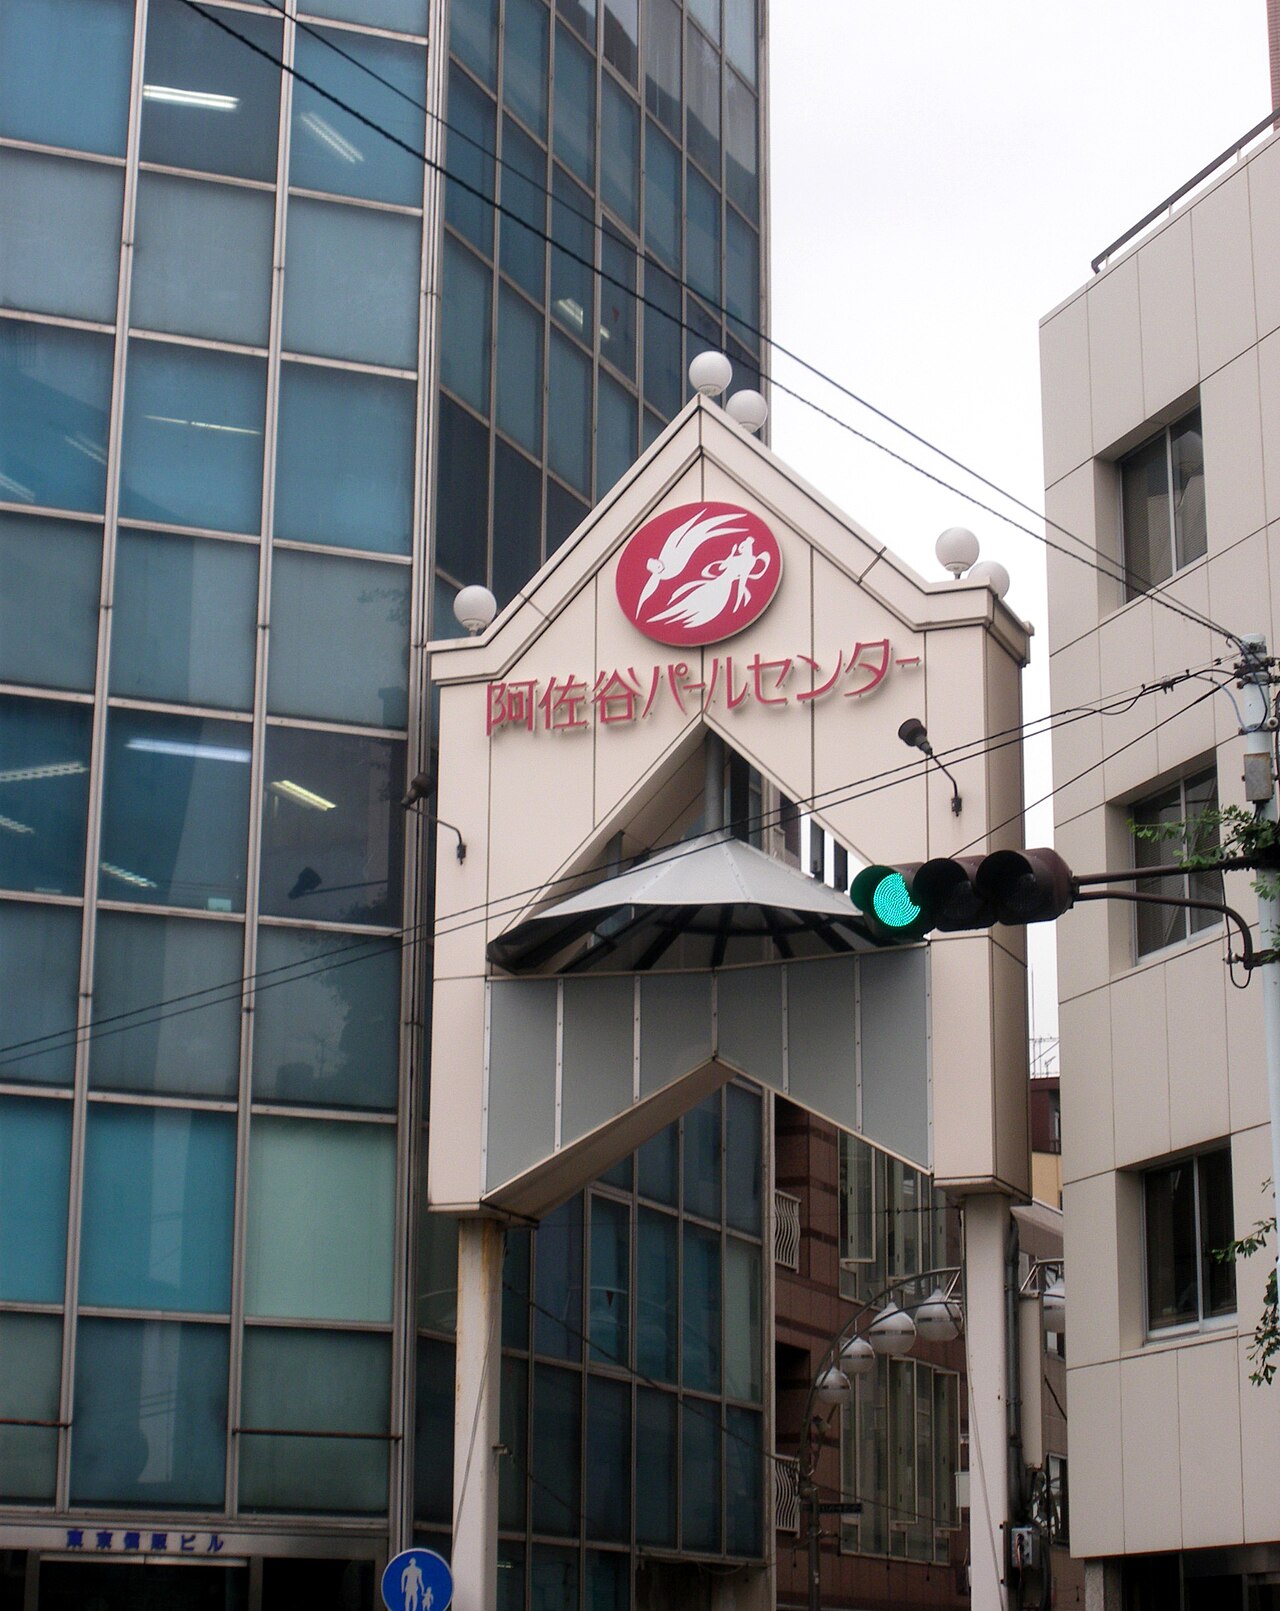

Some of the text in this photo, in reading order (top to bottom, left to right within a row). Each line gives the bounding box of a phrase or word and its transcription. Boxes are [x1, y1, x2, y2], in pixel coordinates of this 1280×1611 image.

[486, 638, 921, 736] 阿佐谷パールセンター
